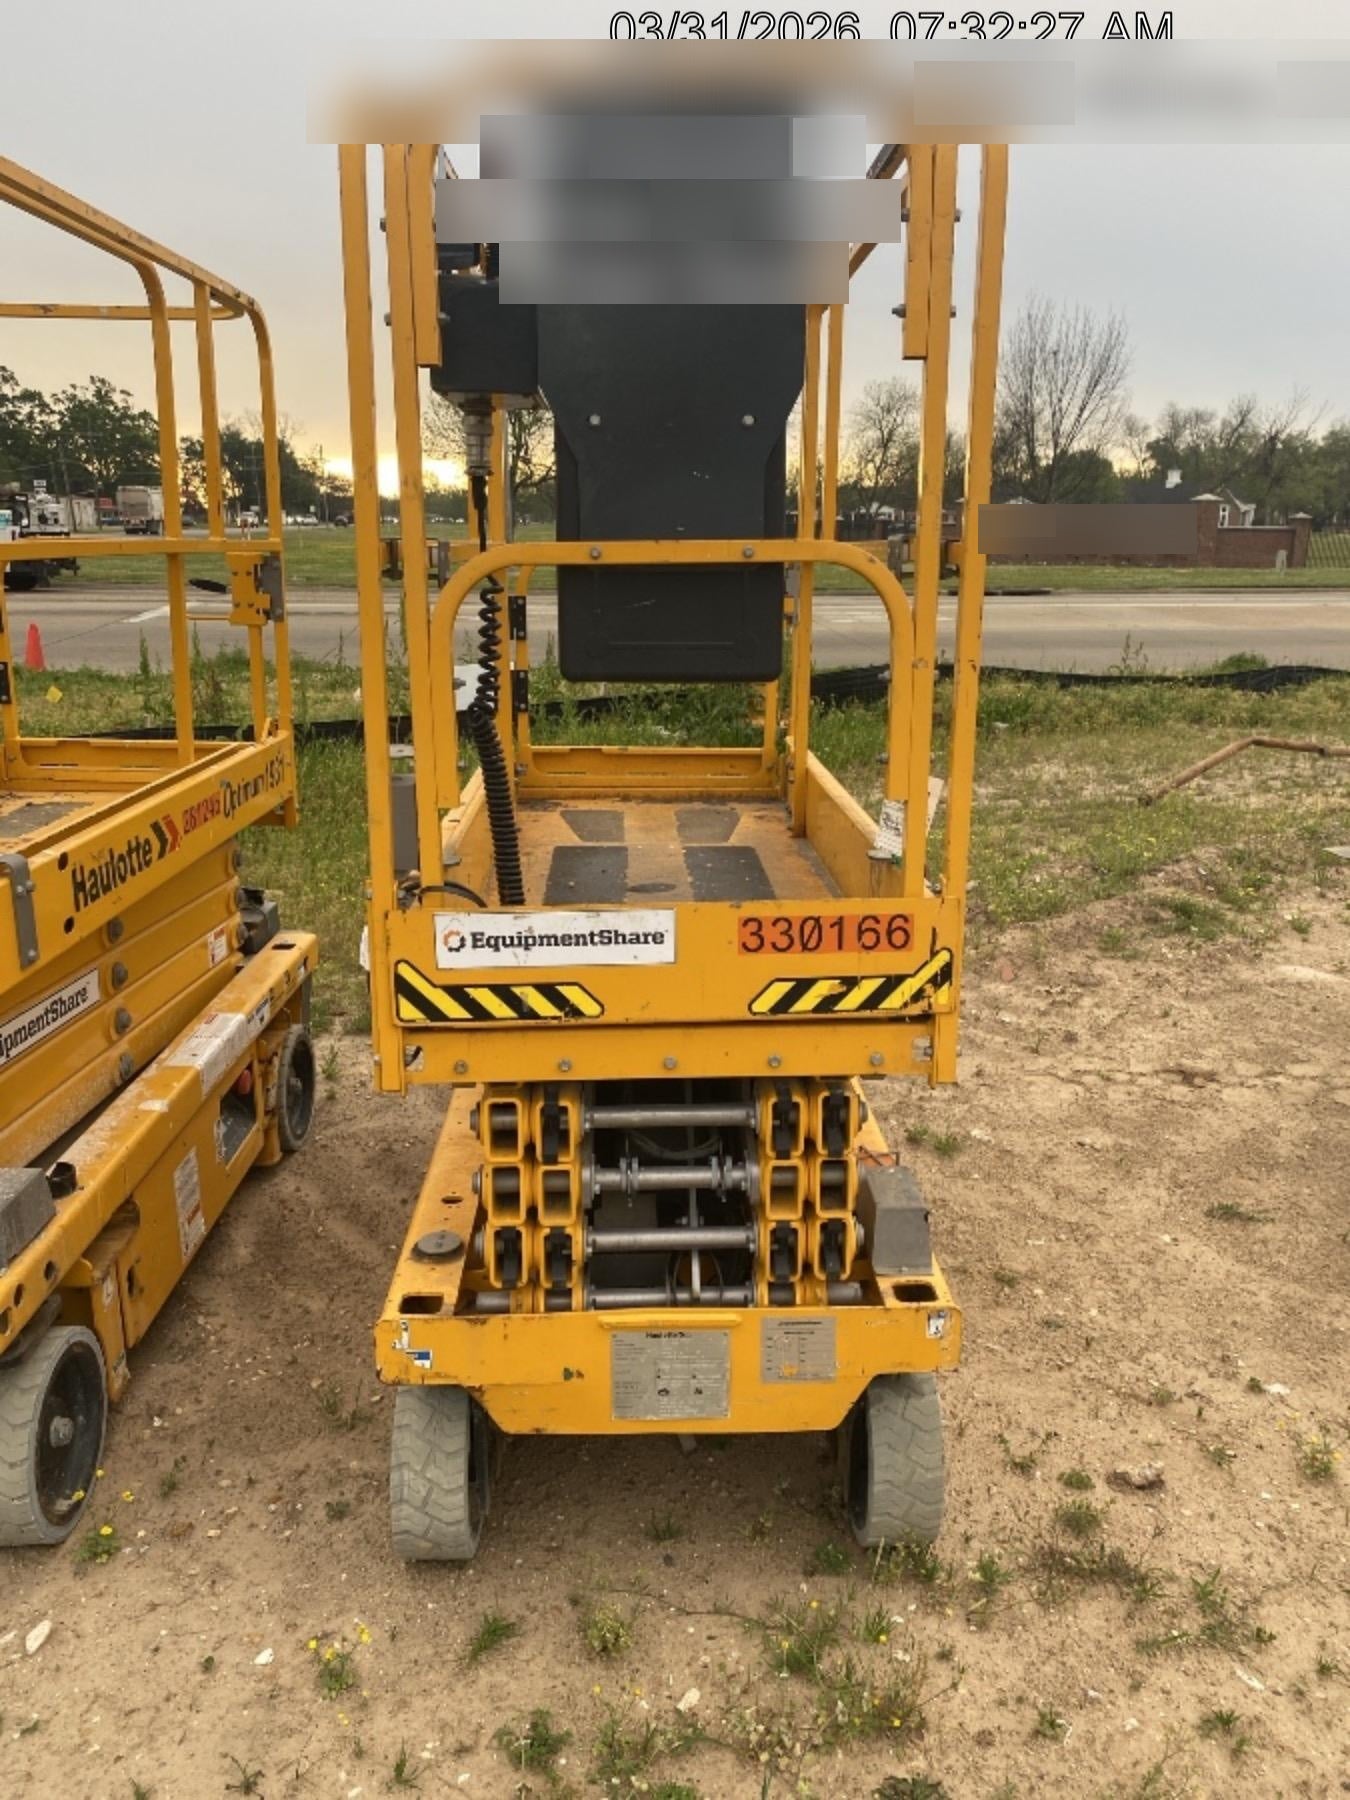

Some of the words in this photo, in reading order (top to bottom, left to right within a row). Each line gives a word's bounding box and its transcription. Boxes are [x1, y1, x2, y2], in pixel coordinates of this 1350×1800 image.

[72, 836, 152, 912] Haulotte
[470, 929, 665, 951] EquipmentShare
[741, 914, 911, 953] 330166
